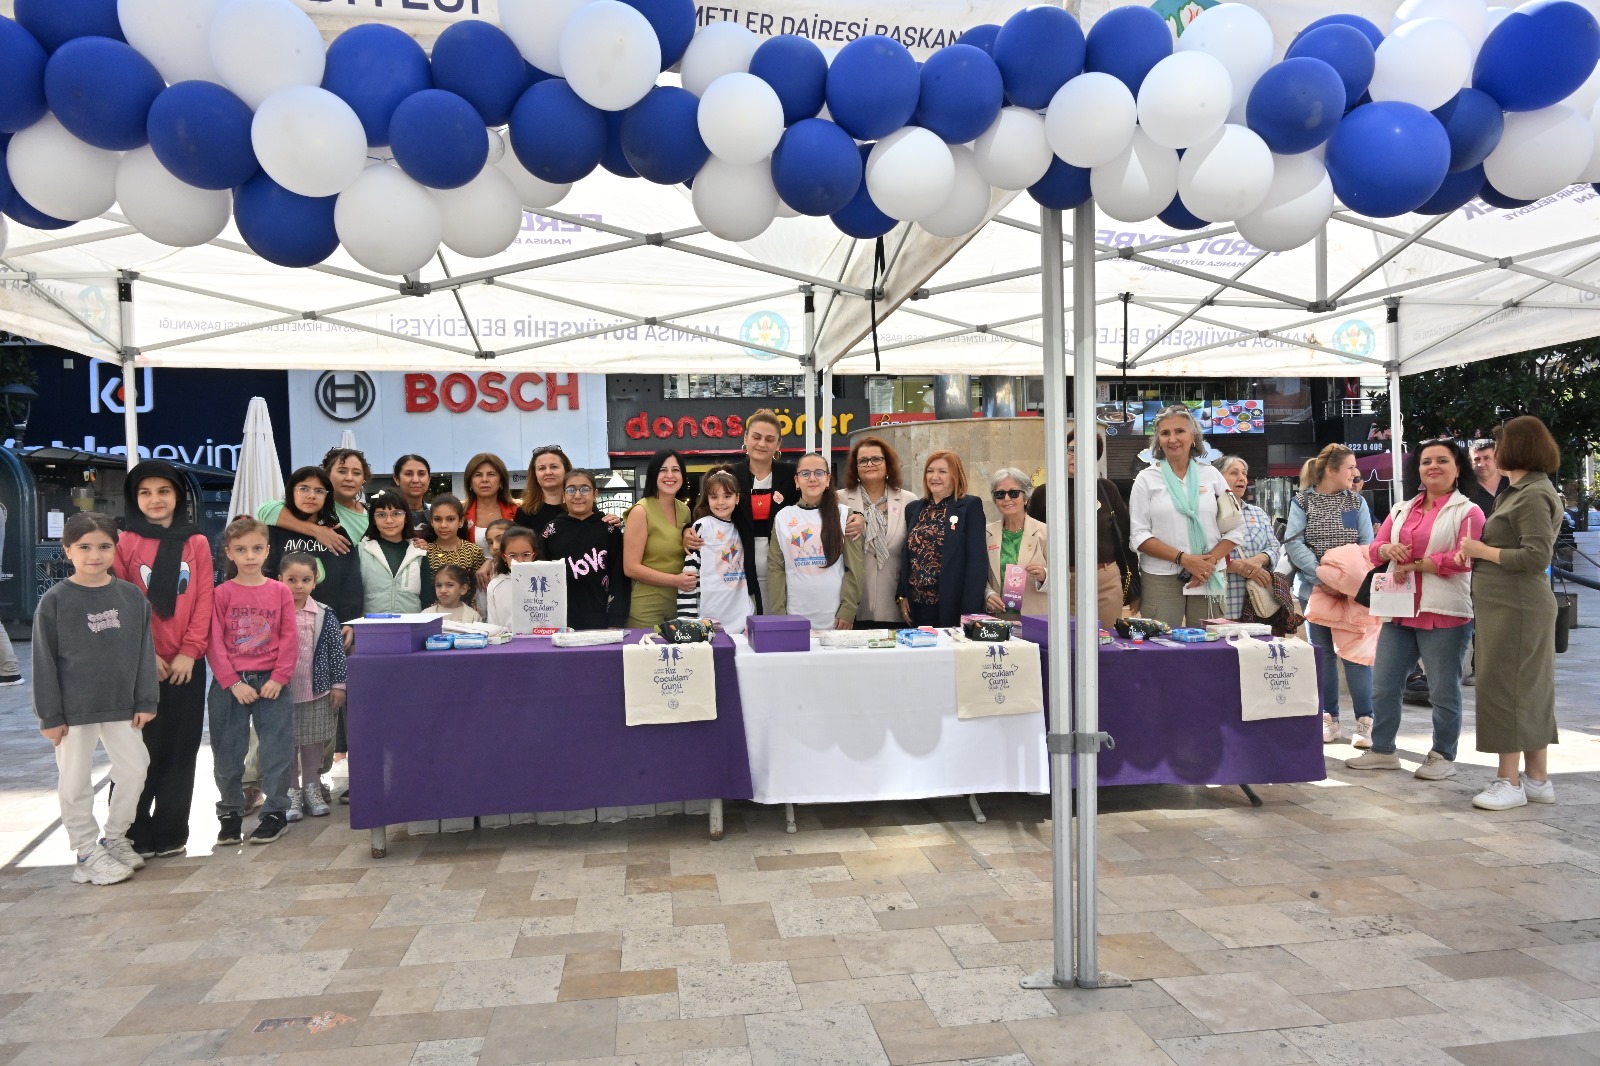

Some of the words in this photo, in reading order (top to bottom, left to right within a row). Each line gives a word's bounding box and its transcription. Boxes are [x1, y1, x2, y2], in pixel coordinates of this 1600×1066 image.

[781, 13, 869, 42] DAİRESİ
[404, 371, 579, 413] BOSCH
[624, 411, 743, 440] donas
[745, 408, 854, 437] öner
